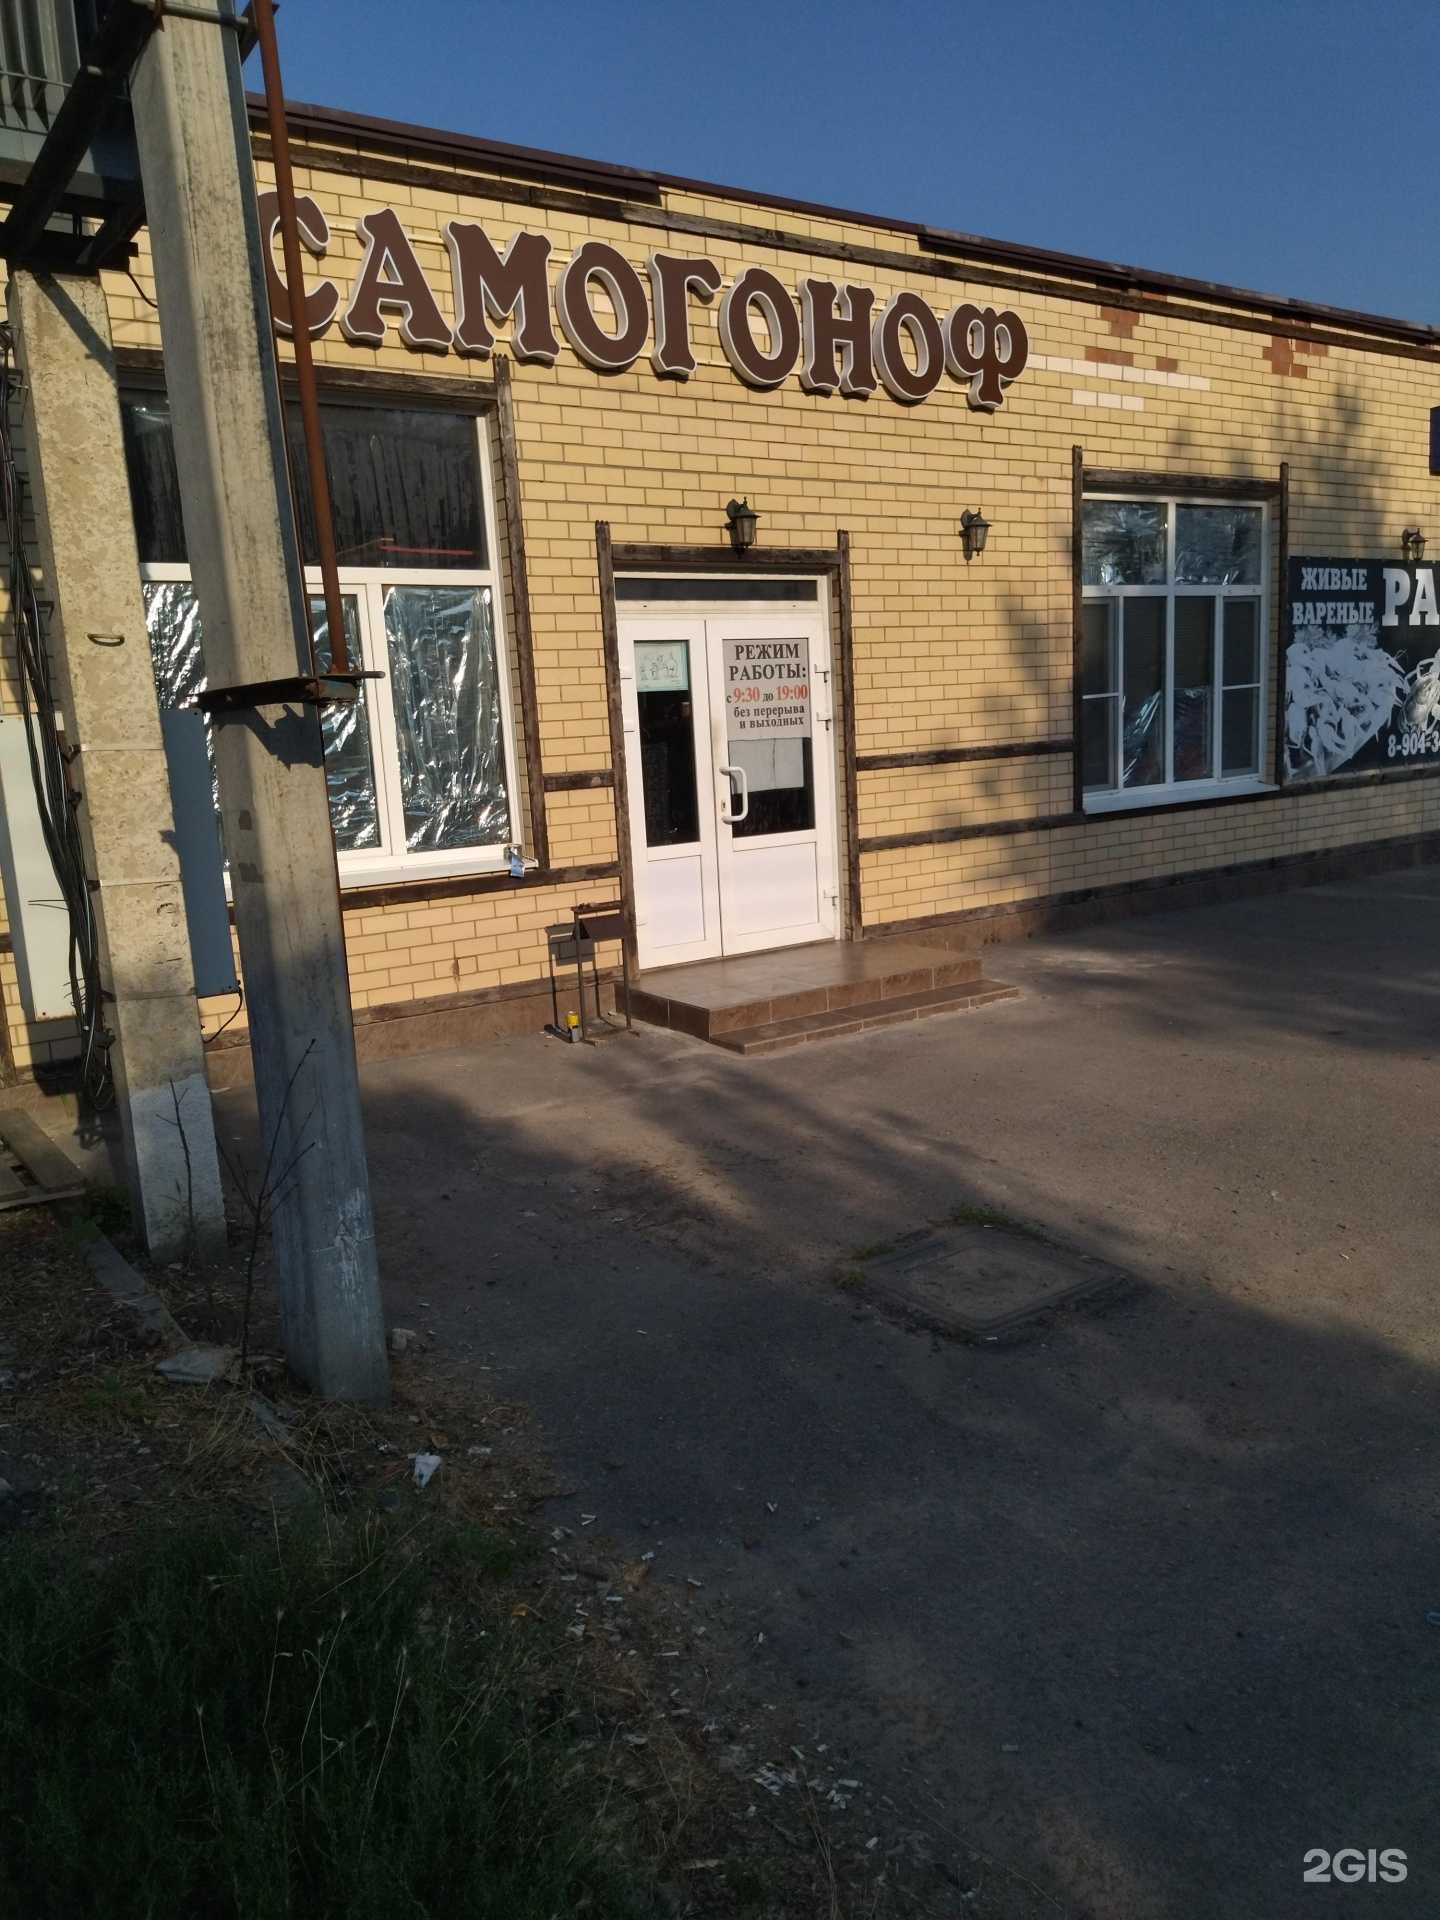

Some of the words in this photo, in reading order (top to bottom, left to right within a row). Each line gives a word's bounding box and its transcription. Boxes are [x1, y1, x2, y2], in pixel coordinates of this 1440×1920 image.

[256, 191, 1029, 409] САМОГОНОФ
[1301, 567, 1368, 591] ЖИВЫЕ
[1292, 602, 1375, 625] ВАРЕНЫЕ
[734, 643, 800, 660] РЕЖИМ
[728, 663, 807, 681] РАБОТЫ:
[734, 686, 760, 703] 9:30
[762, 693, 774, 702] до
[776, 684, 808, 701] 19:00
[734, 706, 750, 718] без
[753, 705, 805, 718] перерыва
[739, 720, 746, 729] и
[749, 717, 804, 729] выходных
[1388, 730, 1440, 757] 8-904-3
